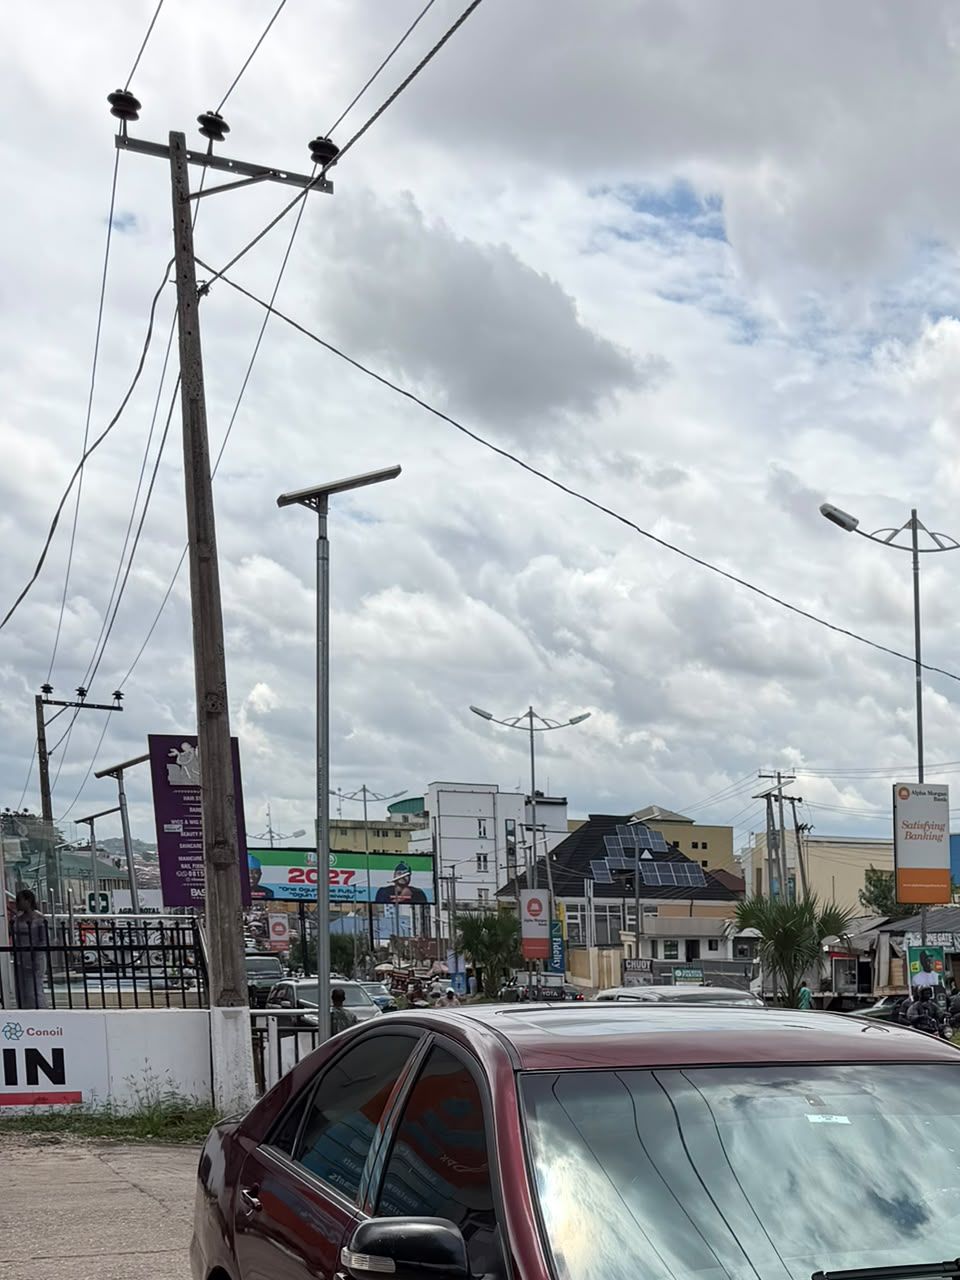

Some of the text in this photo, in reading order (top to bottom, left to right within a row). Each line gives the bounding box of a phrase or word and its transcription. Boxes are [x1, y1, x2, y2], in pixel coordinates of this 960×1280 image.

[901, 820, 946, 832] Satisfying
[904, 831, 944, 843] Banking
[287, 867, 356, 885] 2027
[552, 937, 563, 969] Fidelity
[533, 990, 559, 998] TYOTA
[26, 1026, 63, 1037] Conoil
[2, 1047, 66, 1087] IN
